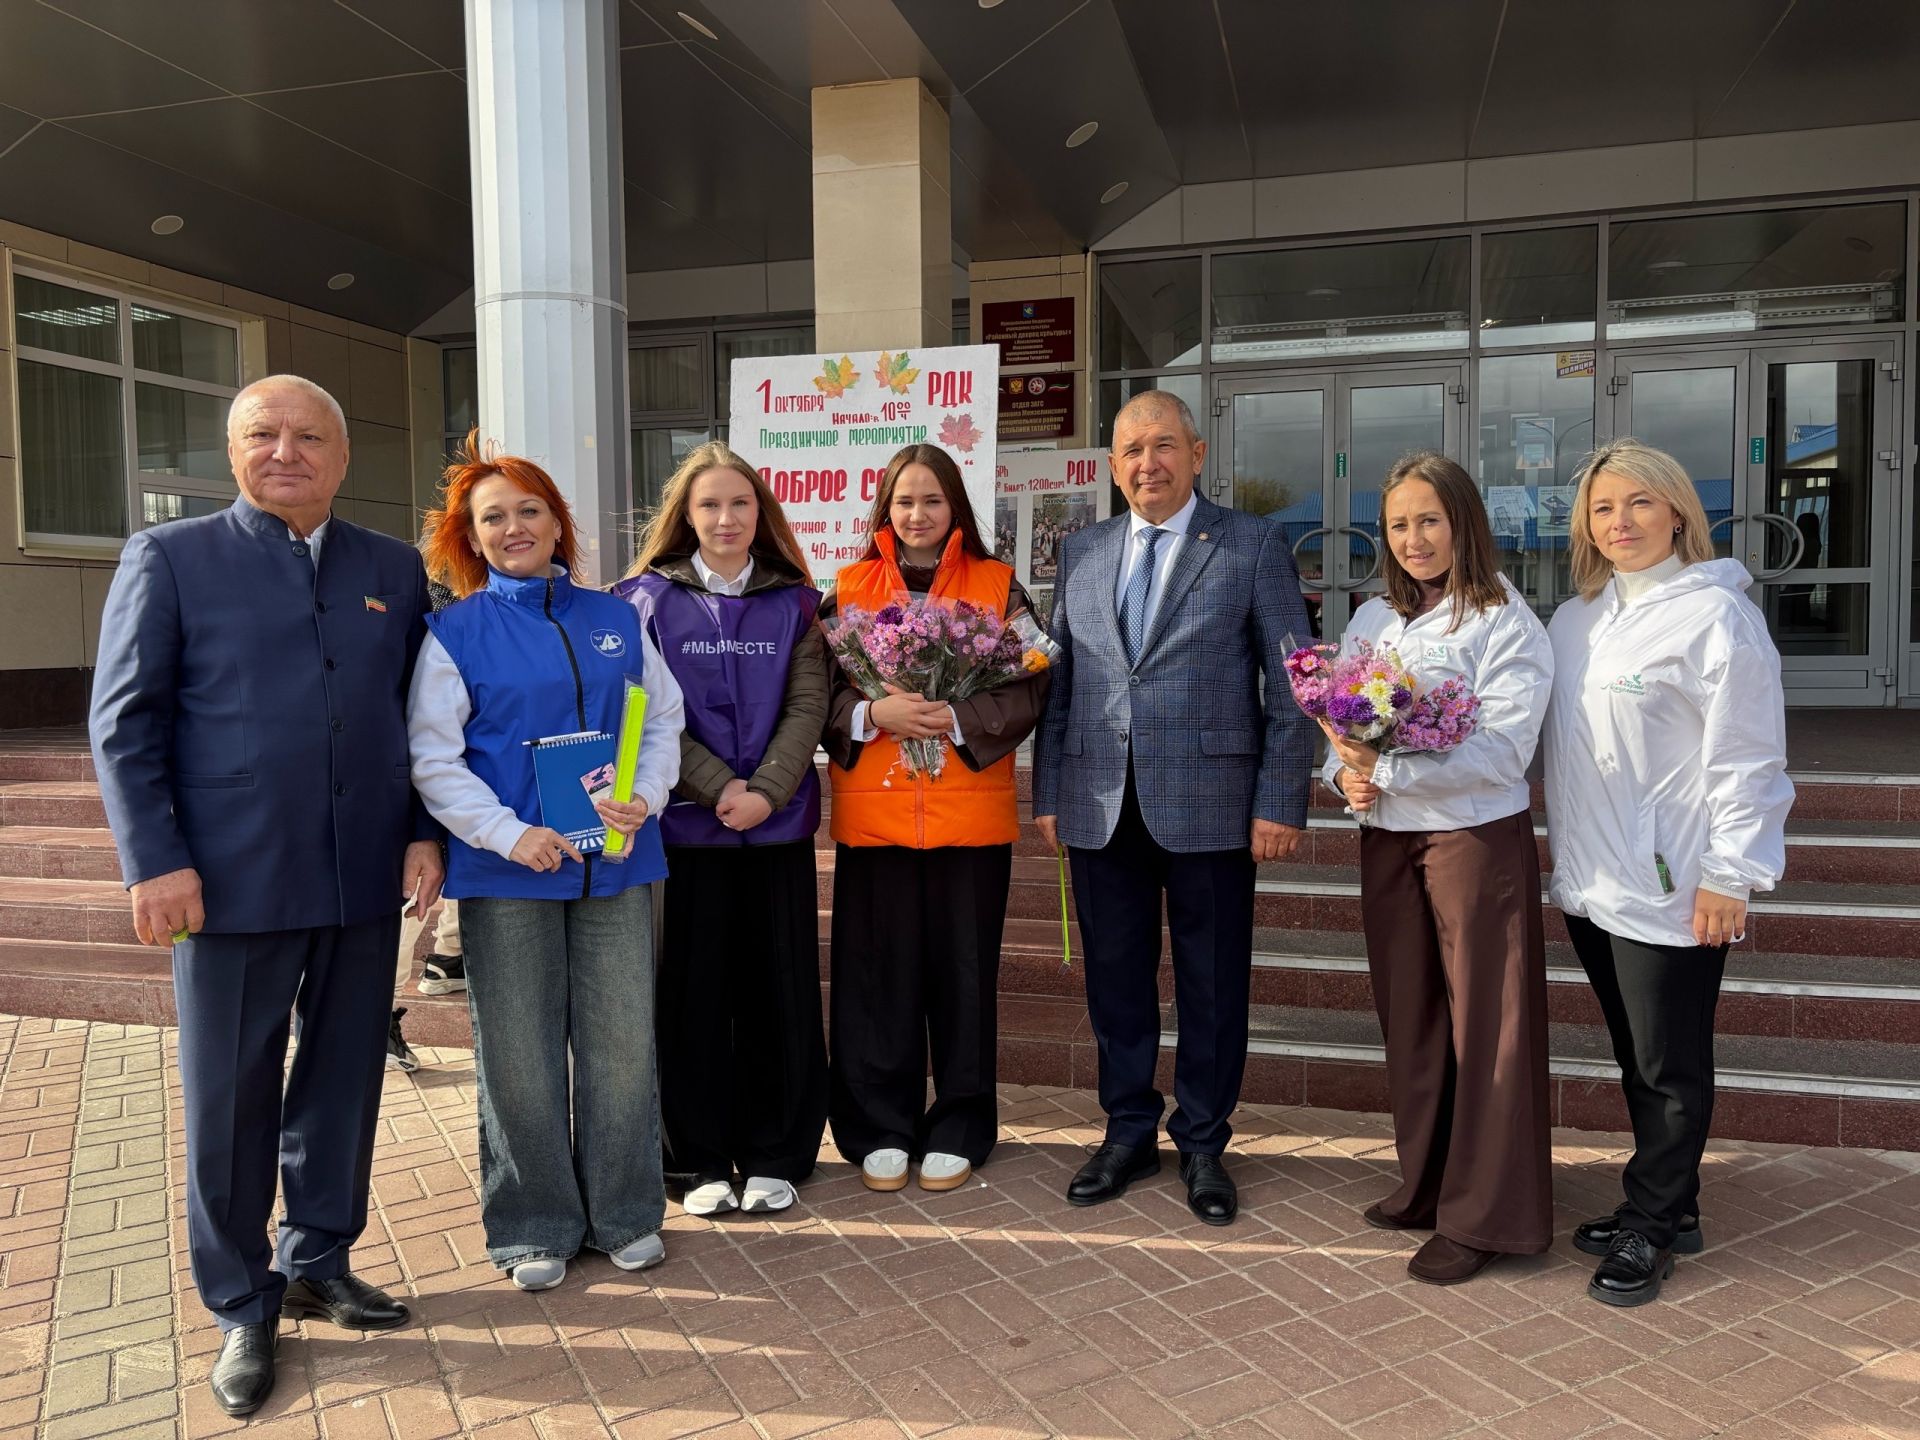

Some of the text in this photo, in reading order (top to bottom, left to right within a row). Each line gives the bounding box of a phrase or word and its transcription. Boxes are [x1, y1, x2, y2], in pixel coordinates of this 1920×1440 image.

[755, 379, 772, 414] 1
[928, 371, 972, 408] РДК
[1030, 400, 1044, 408] ЗАГС
[1066, 460, 1096, 485] РДК
